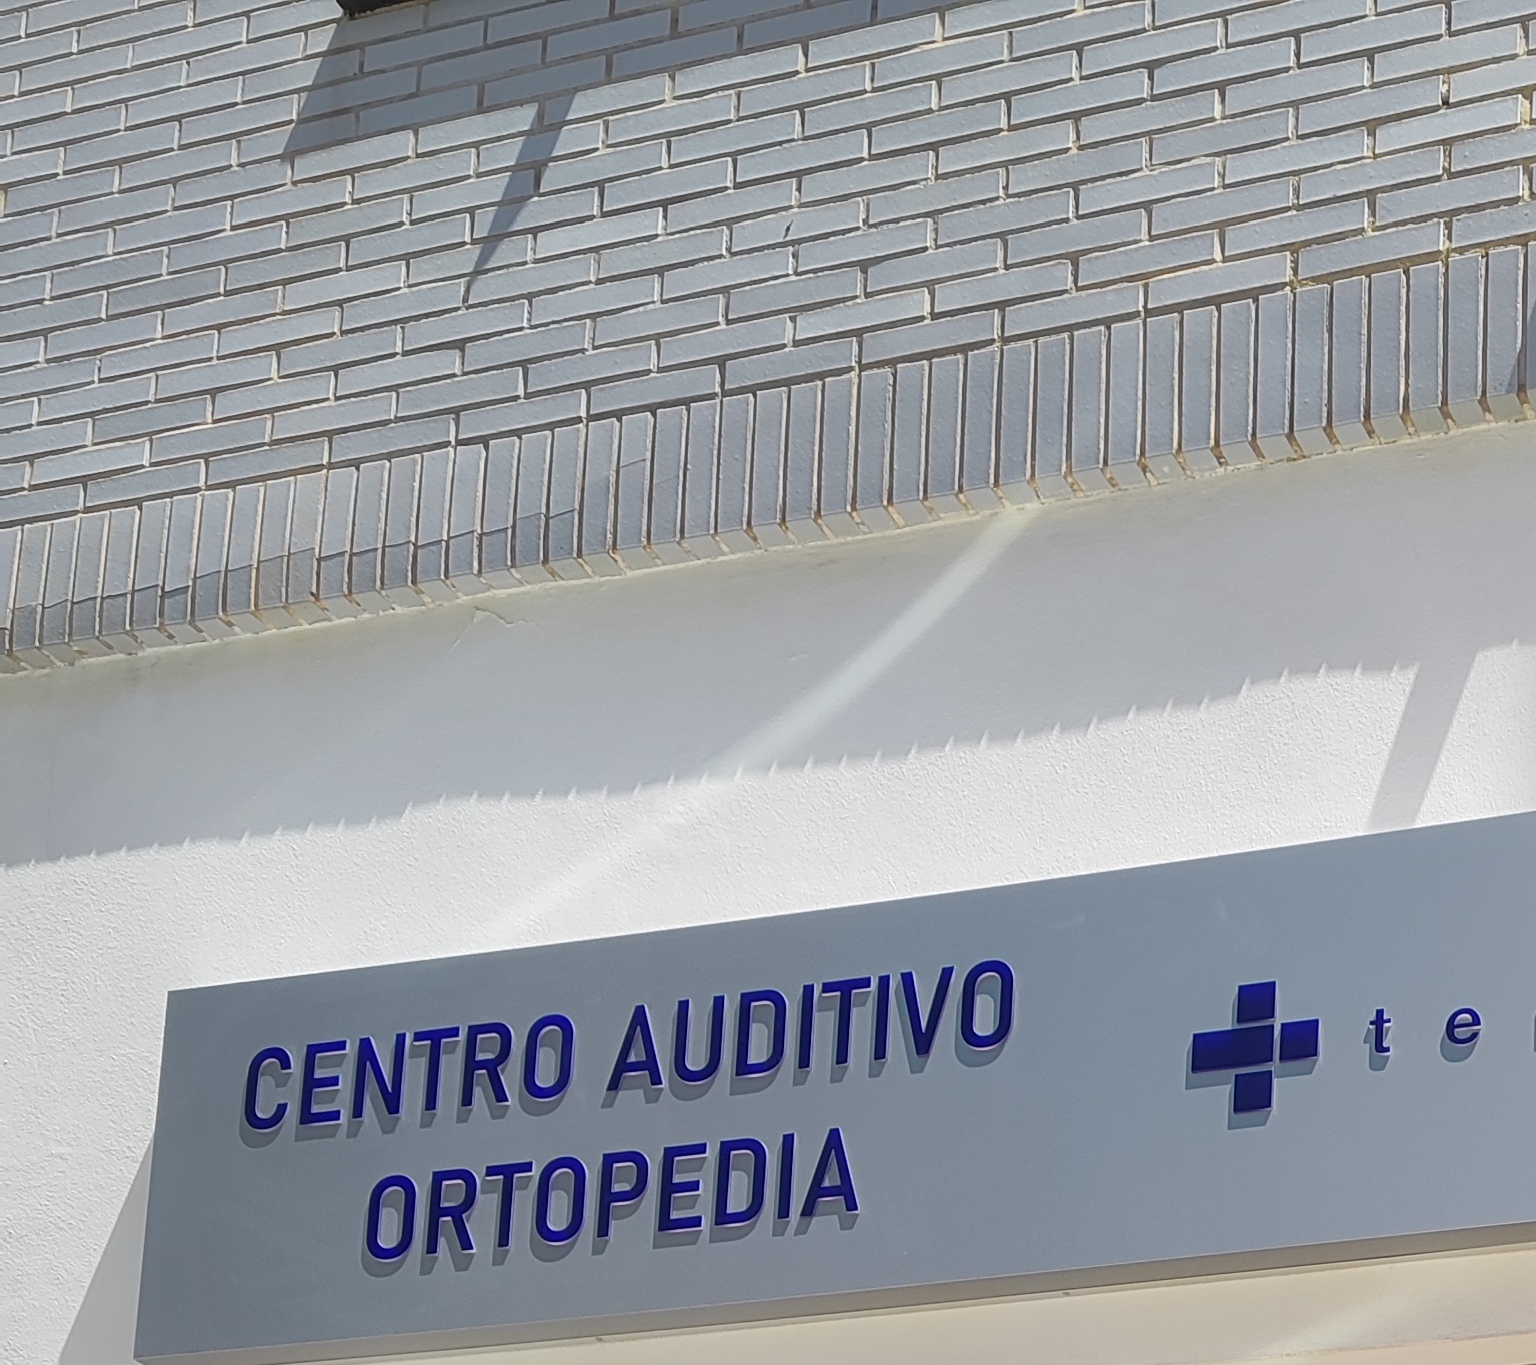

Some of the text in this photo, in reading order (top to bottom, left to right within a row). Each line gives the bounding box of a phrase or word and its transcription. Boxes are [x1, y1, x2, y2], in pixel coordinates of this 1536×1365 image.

[243, 958, 1016, 1132] CENTRO AUDITIVO
[364, 1126, 860, 1262] ORTOPEDIA
